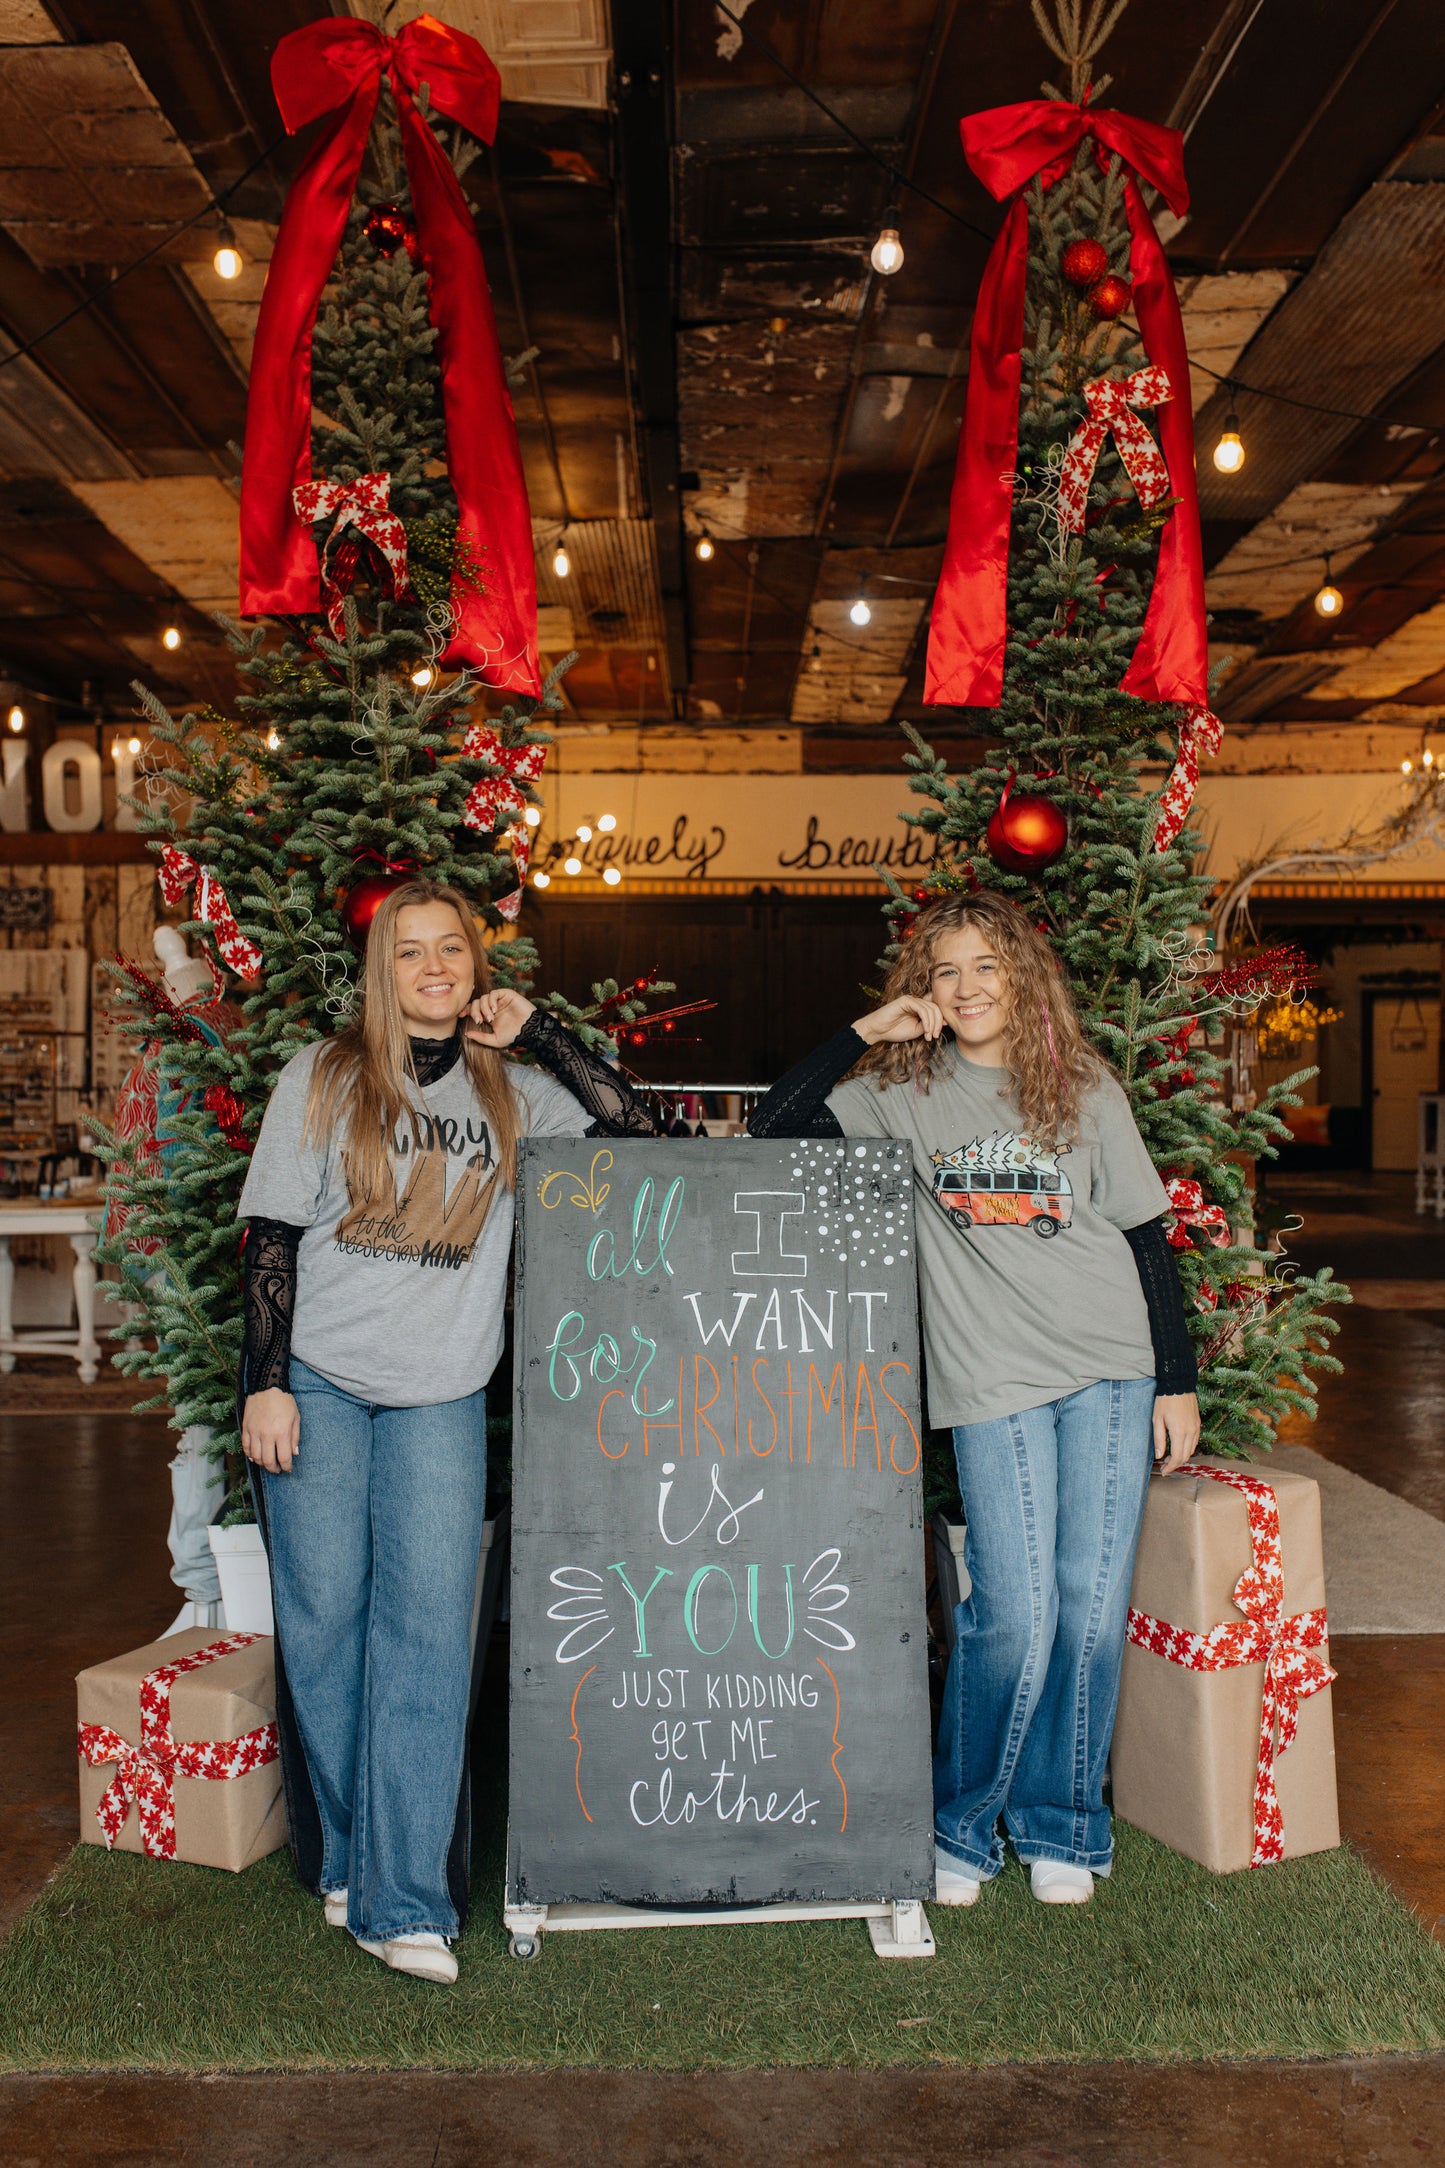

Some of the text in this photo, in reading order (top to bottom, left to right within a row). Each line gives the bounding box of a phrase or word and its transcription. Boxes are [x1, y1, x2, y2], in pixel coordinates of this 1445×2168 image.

[778, 814, 963, 872] beautif
[353, 1213, 414, 1244] to the
[419, 1239, 470, 1271] KING
[586, 1175, 807, 1281] all I
[682, 1287, 889, 1353] WANT
[545, 1309, 676, 1418] for
[658, 1461, 765, 1546] is
[606, 1560, 796, 1660] YOU
[611, 1668, 819, 1709] JUST KIDDING
[730, 1717, 777, 1765] ME
